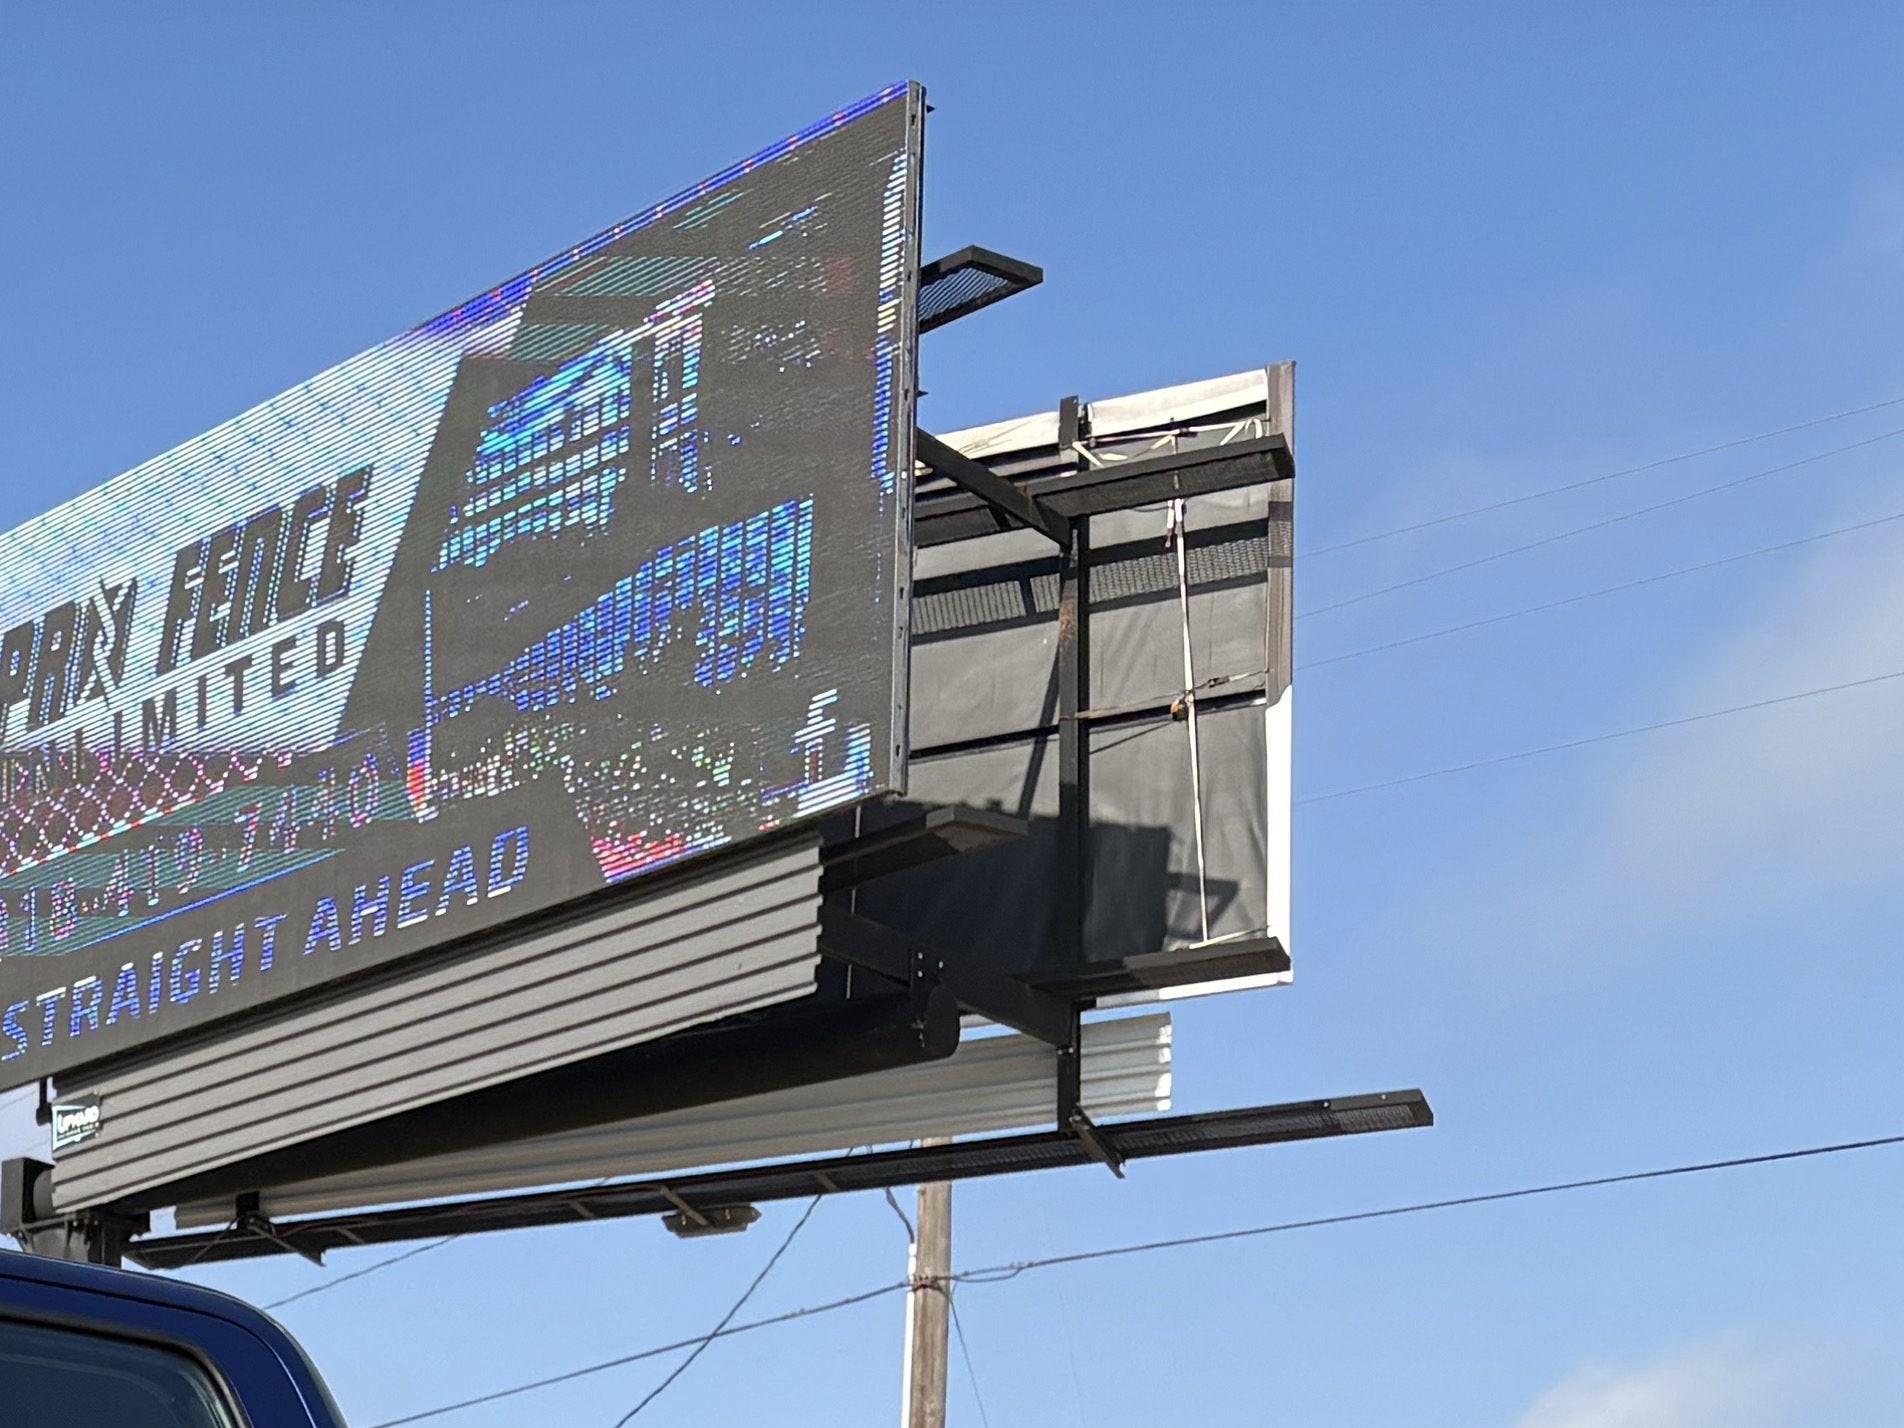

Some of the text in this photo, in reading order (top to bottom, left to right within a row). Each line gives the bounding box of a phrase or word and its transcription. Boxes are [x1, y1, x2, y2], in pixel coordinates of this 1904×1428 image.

[156, 466, 373, 677] FENCE
[0, 825, 530, 1062] STRAIGHT AHEAD
